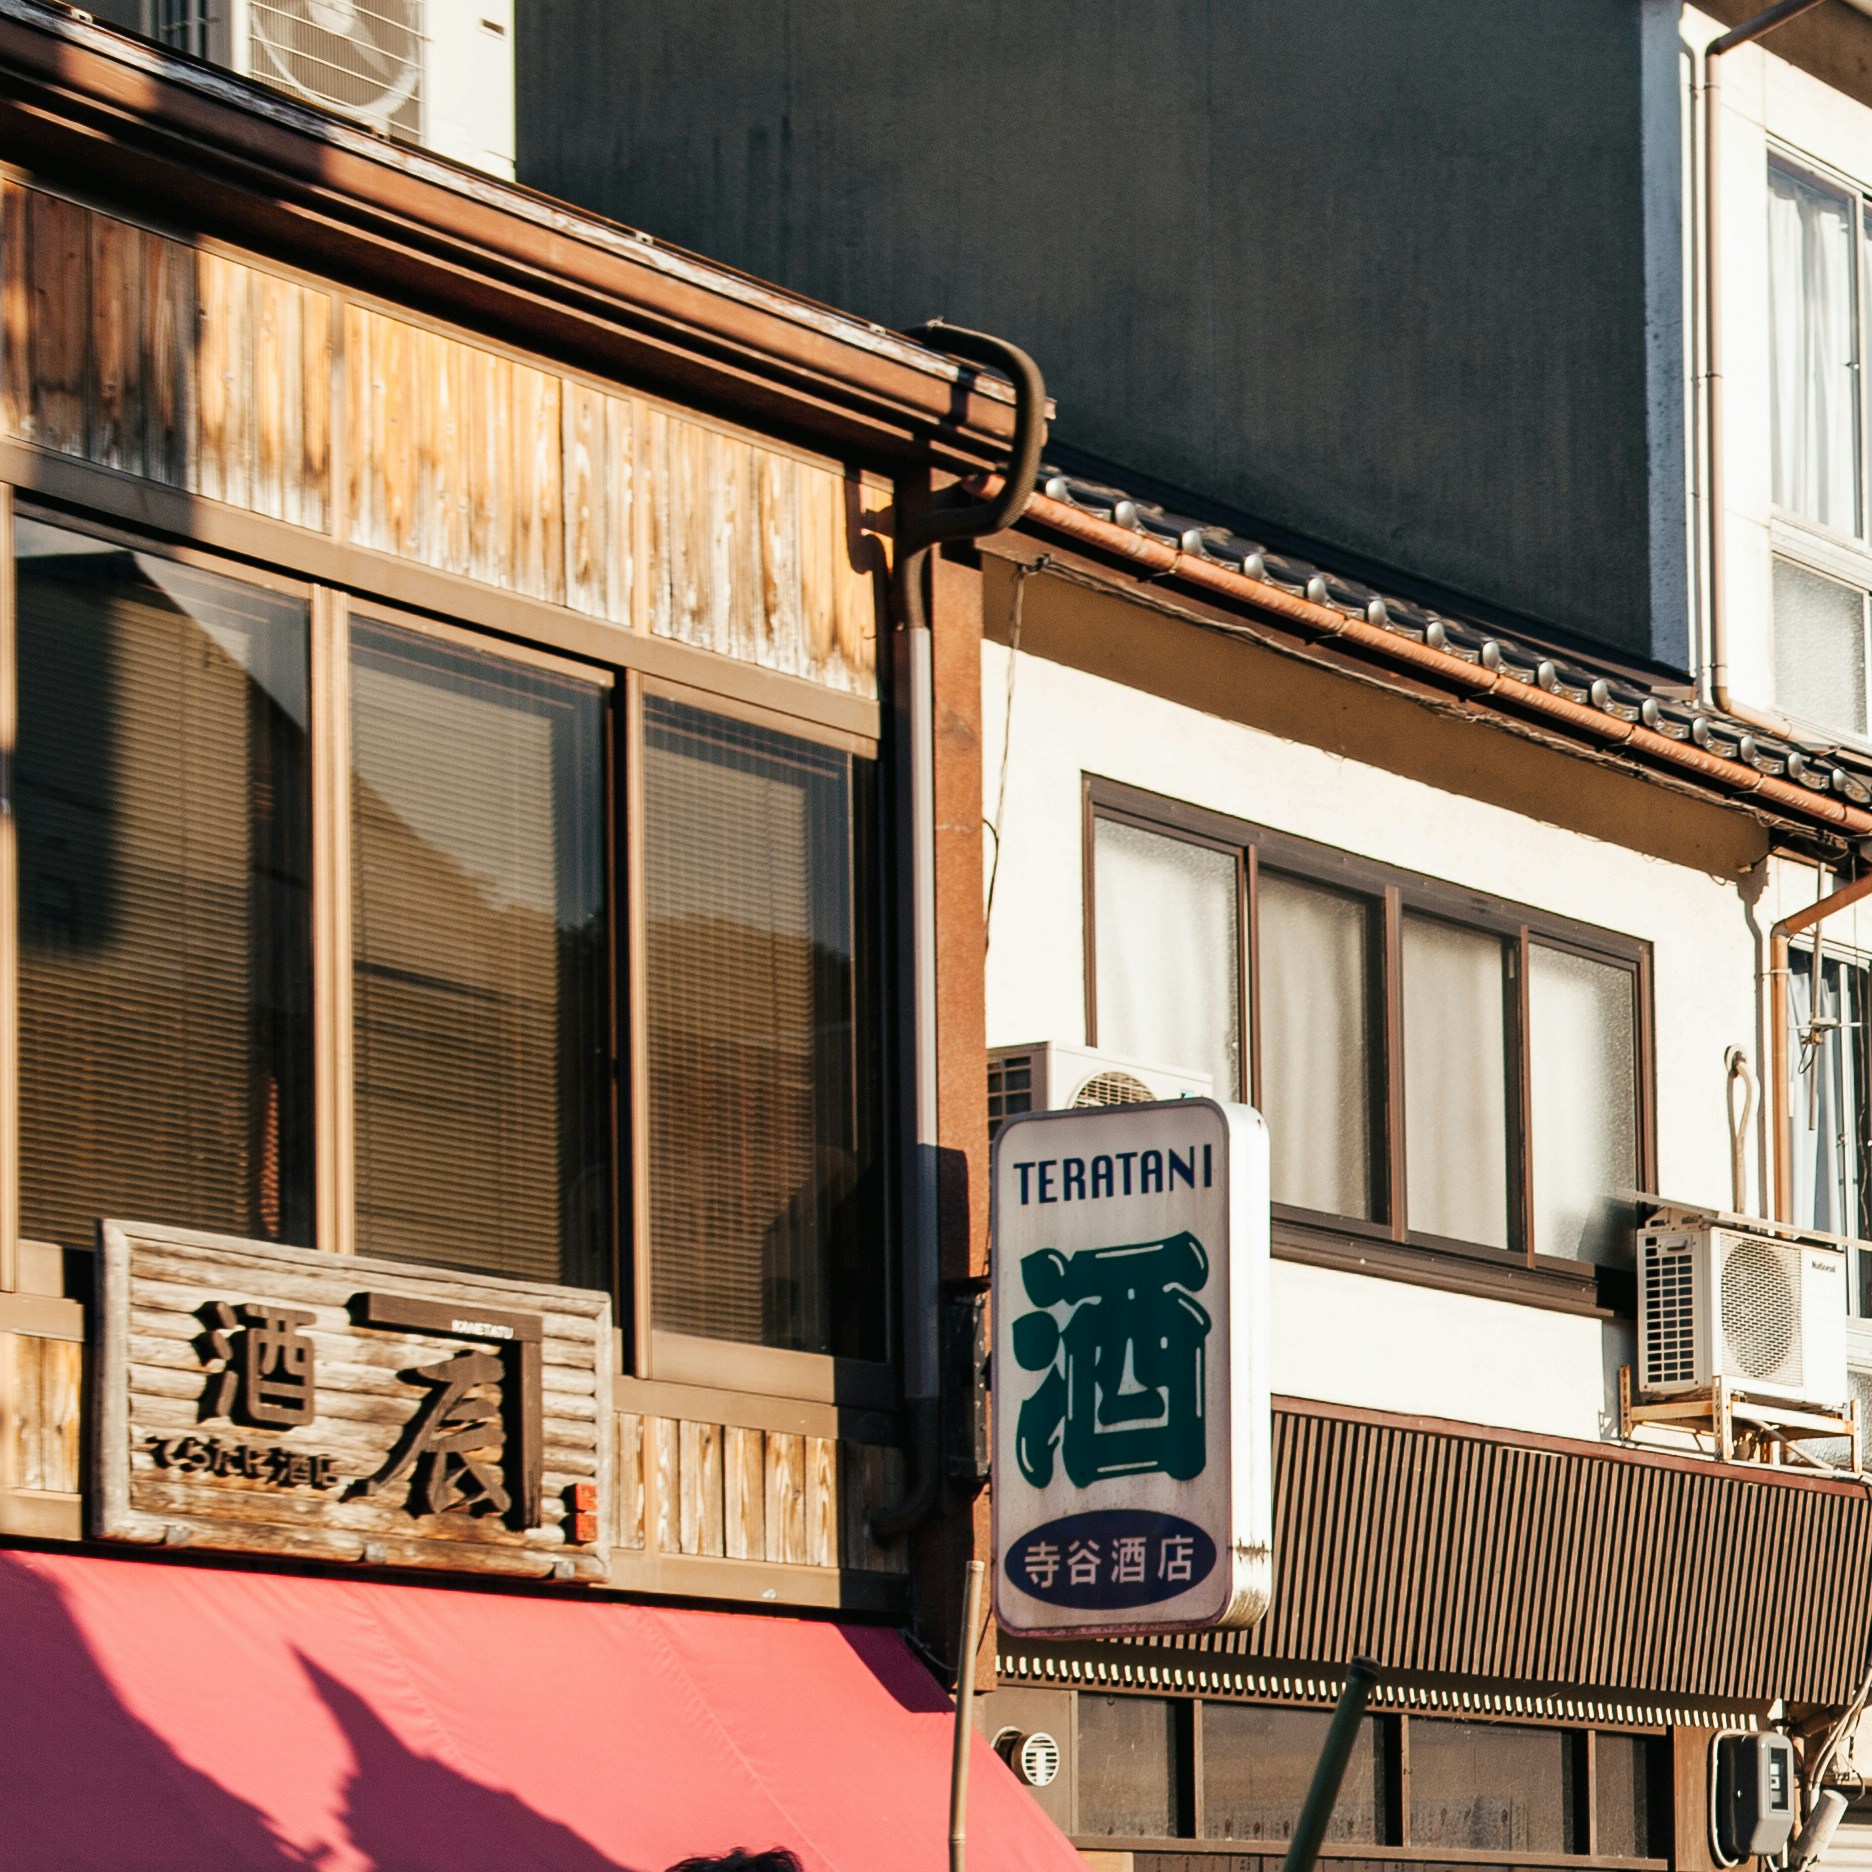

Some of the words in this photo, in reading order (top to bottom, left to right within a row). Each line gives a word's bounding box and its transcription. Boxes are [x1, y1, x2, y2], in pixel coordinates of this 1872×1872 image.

[1013, 1144, 1212, 1205] TERATANI
[199, 1301, 317, 1426] 酒
[1011, 1230, 1212, 1488] 酒
[366, 1349, 512, 1514] 辰
[1024, 1534, 1194, 1588] 寺谷酒店
